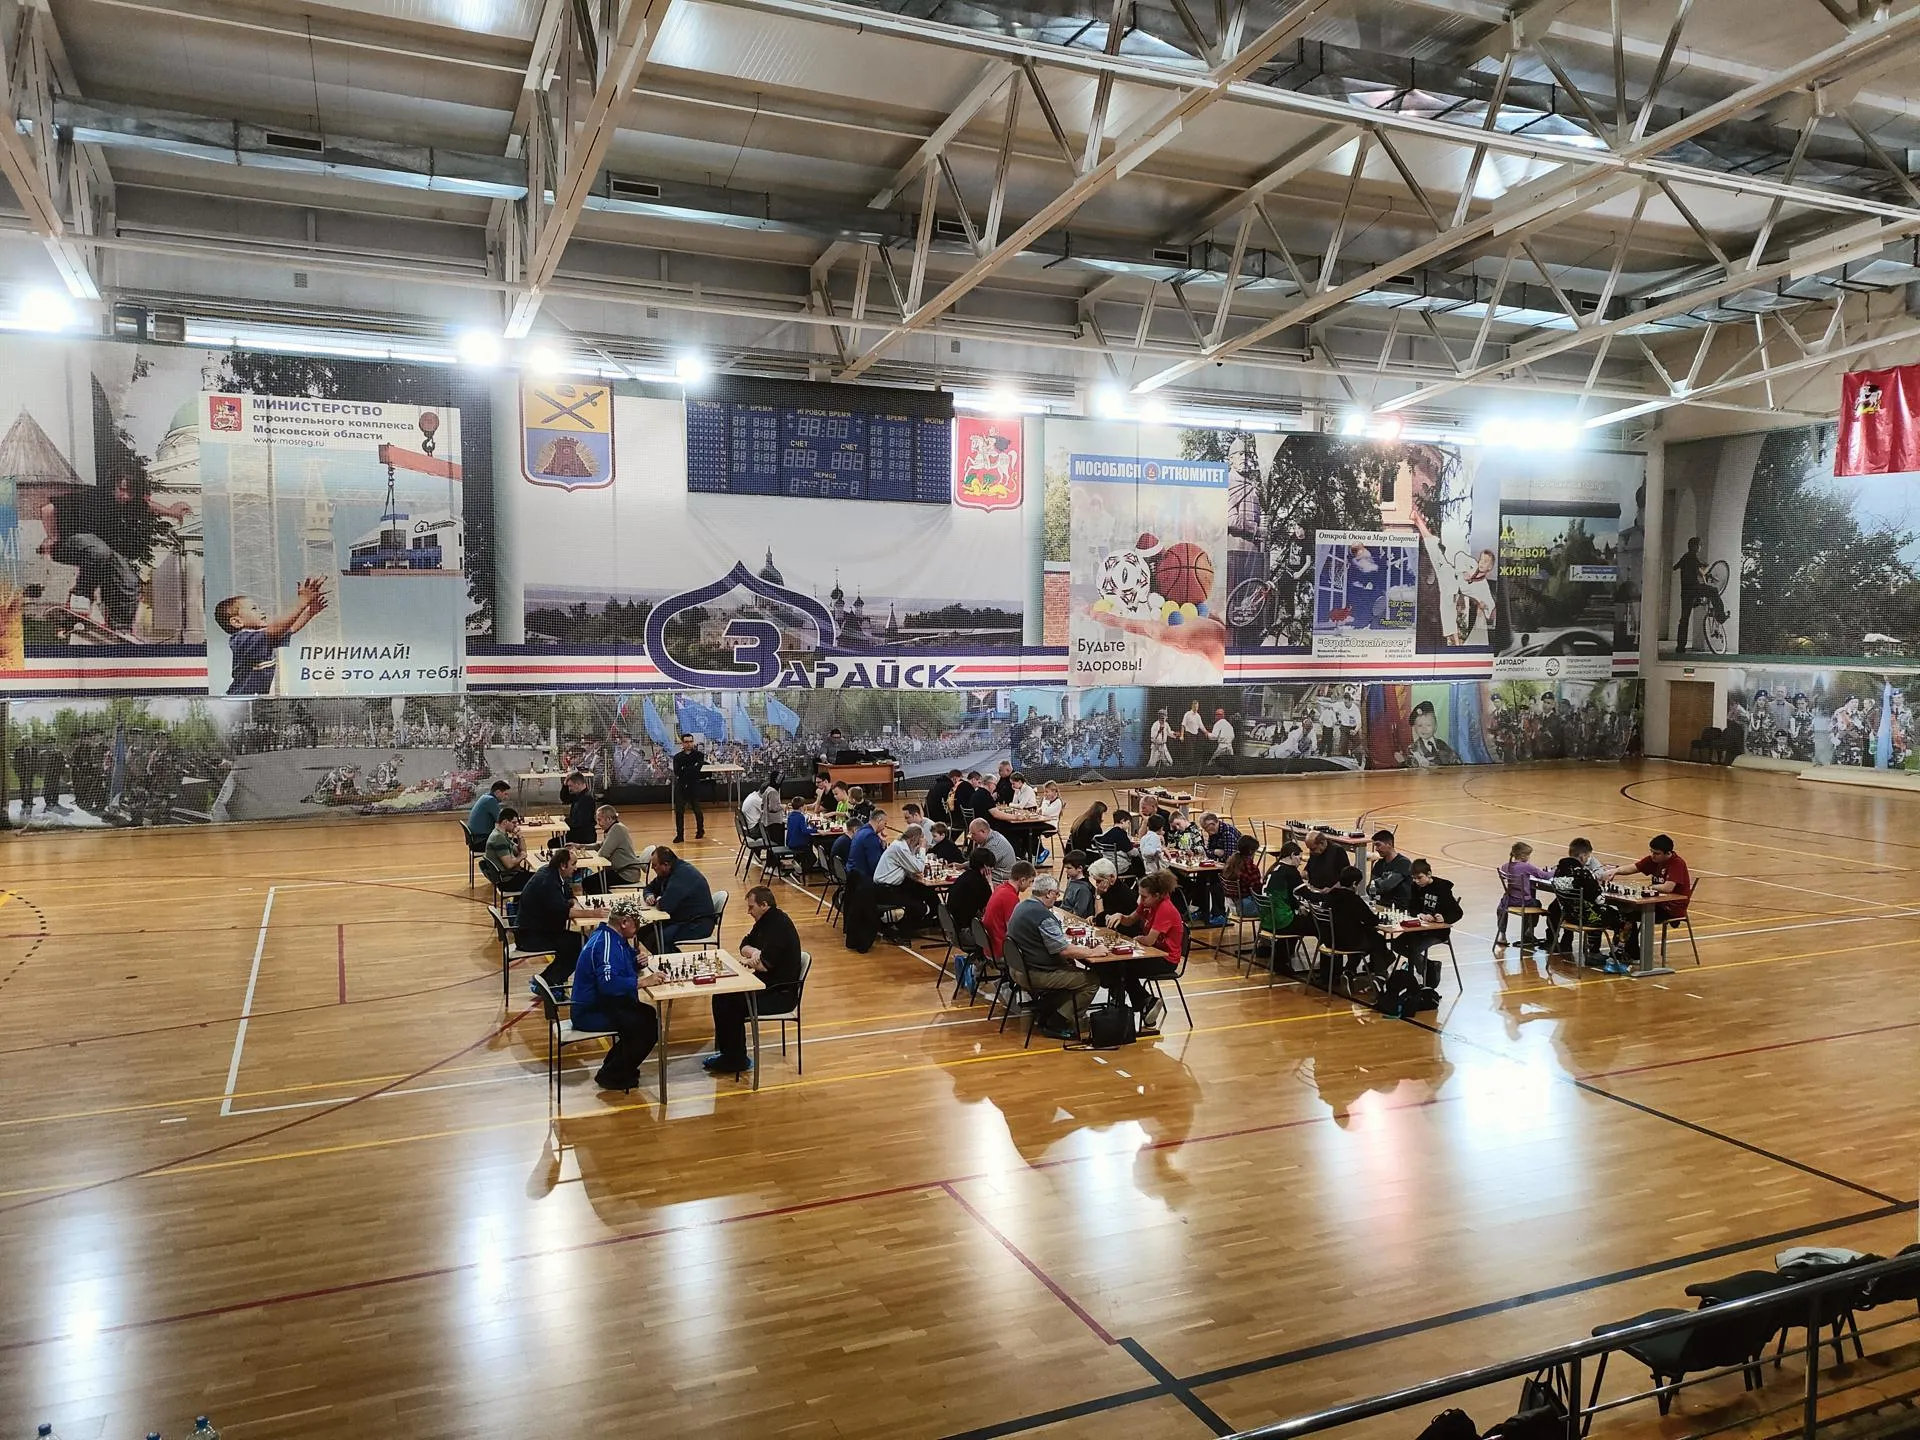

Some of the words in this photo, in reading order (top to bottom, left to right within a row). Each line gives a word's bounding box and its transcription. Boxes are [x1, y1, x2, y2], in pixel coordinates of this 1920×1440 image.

[252, 399, 383, 416] МИНИСТЕРСТВО
[253, 414, 345, 426] строительного
[348, 420, 414, 431] комплекса
[253, 425, 330, 438] Московской
[333, 430, 384, 440] области
[253, 437, 325, 448] www.mosreg.ru
[1499, 563, 1540, 577] жизни!
[299, 642, 411, 660] ПРИНИМАЙ!
[1077, 638, 1126, 655] Будьте
[300, 666, 336, 681] Всё
[340, 669, 374, 680] это
[378, 668, 411, 681] для
[416, 665, 463, 680] тебя!
[1076, 657, 1142, 674] здоровы!
